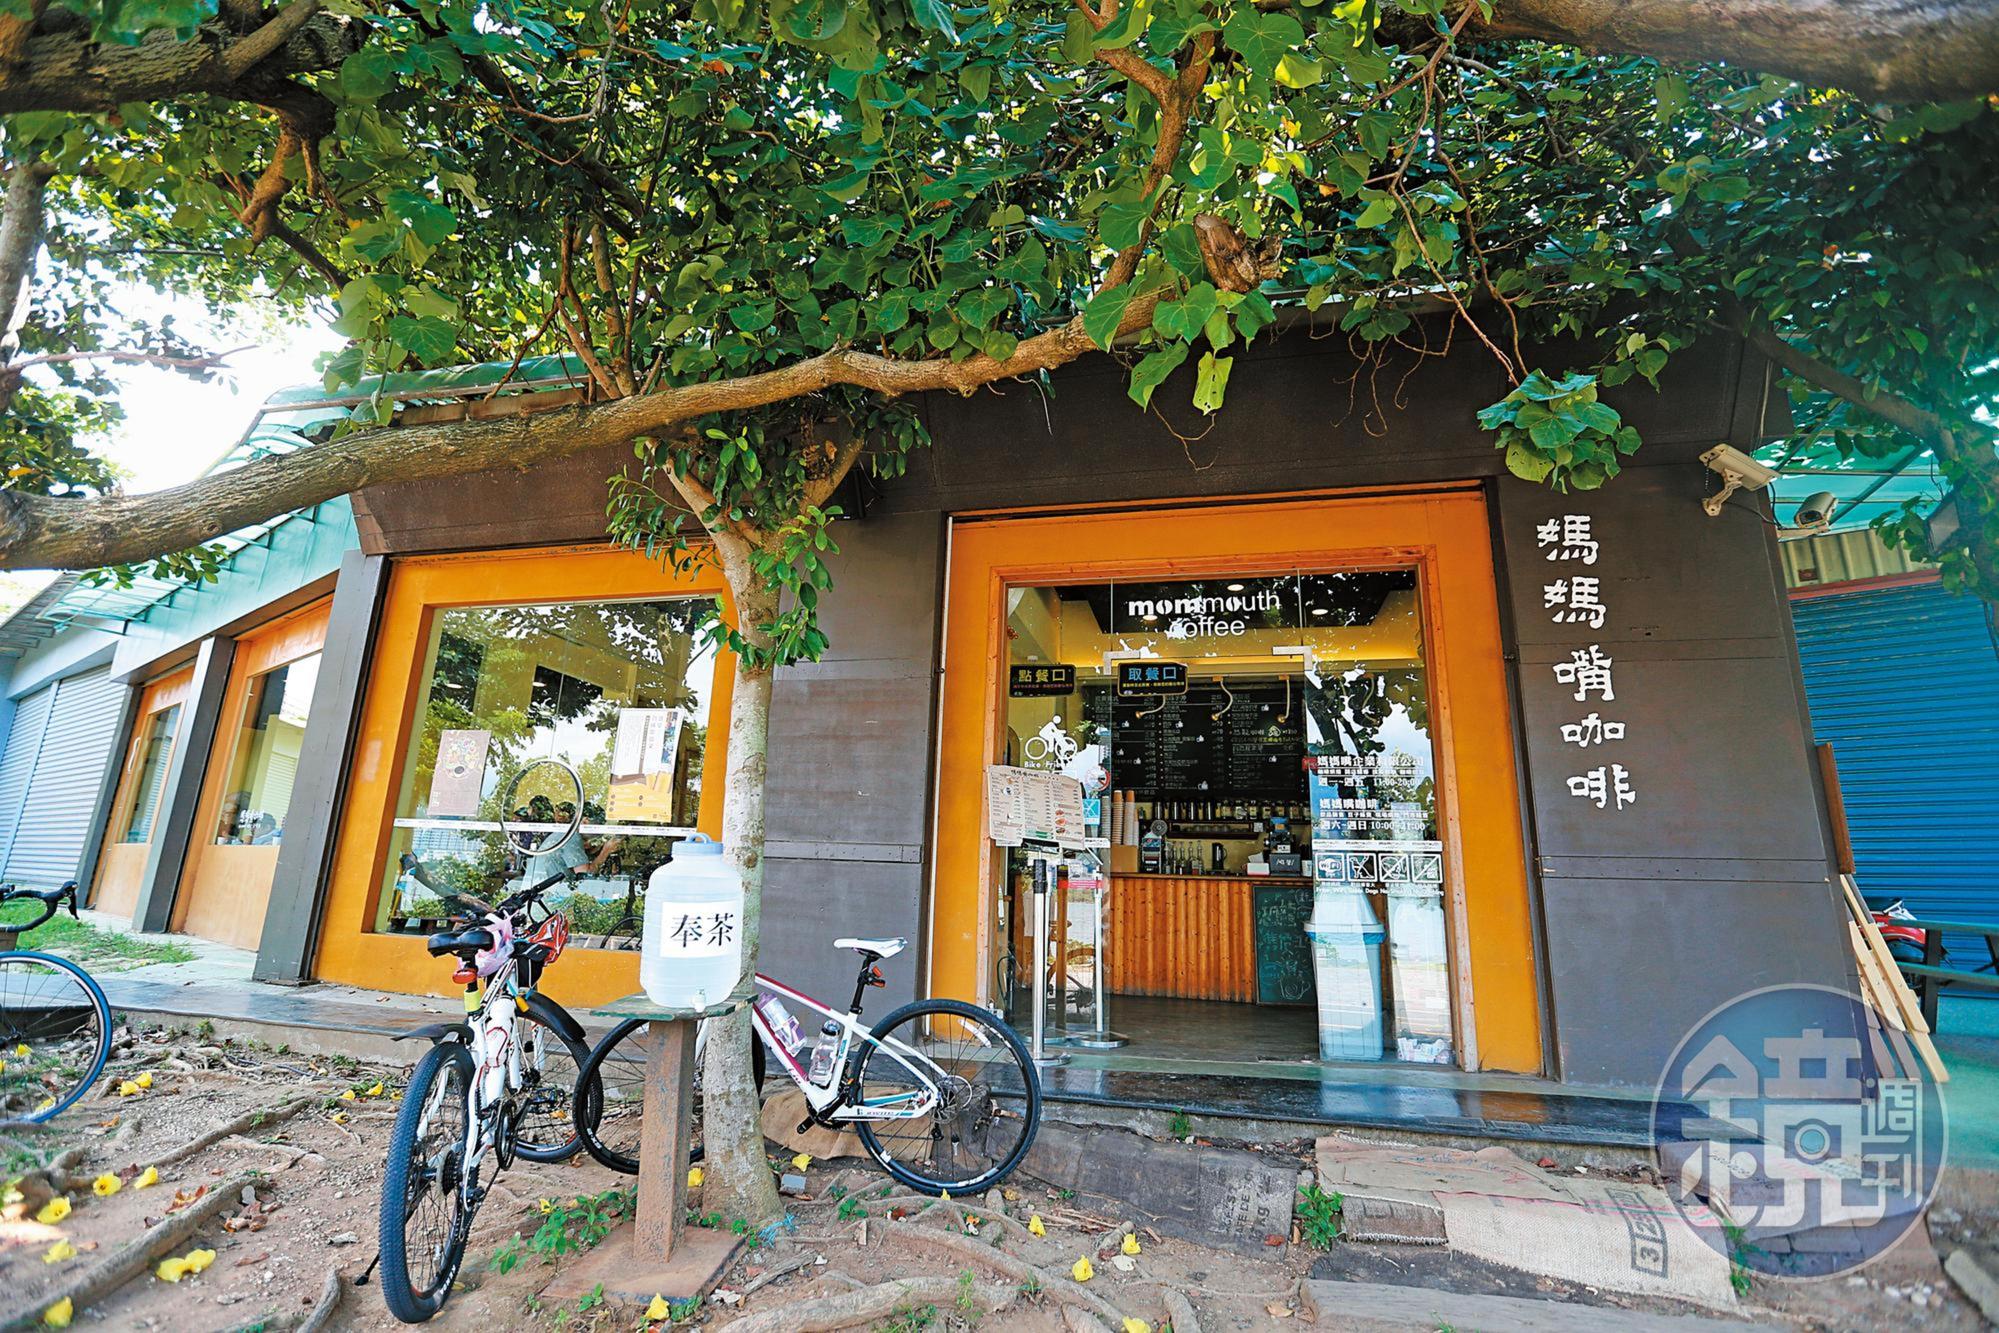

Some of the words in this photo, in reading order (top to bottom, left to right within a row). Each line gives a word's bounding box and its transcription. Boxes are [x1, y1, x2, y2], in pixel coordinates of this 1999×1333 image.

[1128, 666, 1178, 681] 取餐口
[1536, 514, 1636, 811] 媽媽嘴咖啡
[1018, 668, 1066, 683] 點餐口
[670, 912, 734, 948] 奉茶
